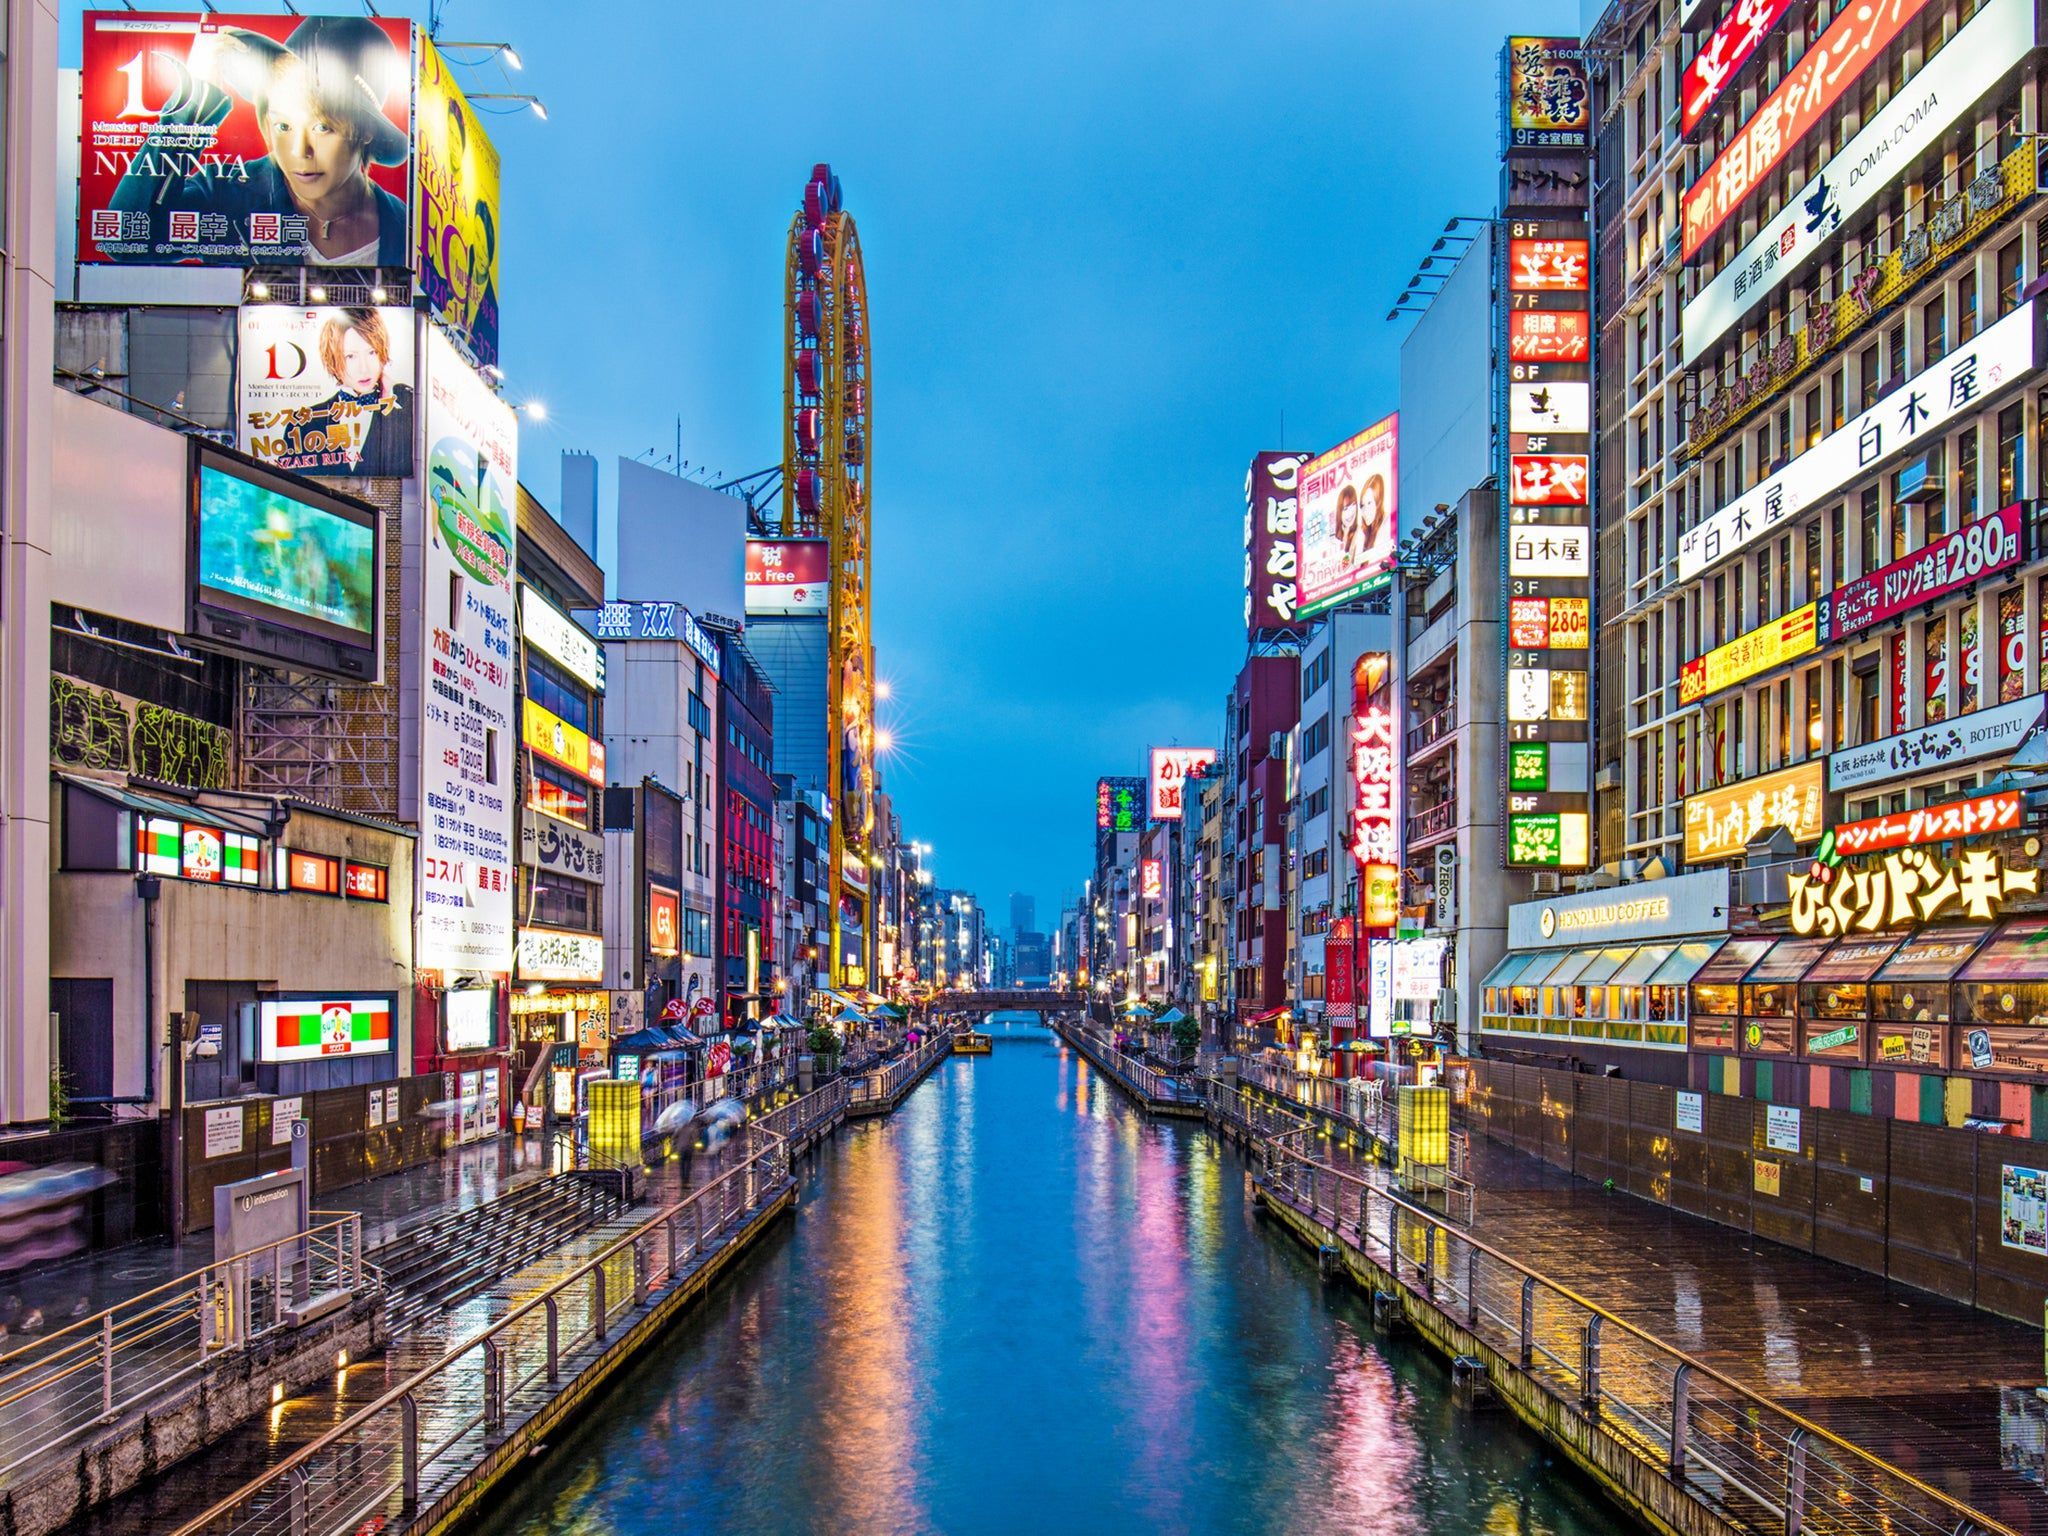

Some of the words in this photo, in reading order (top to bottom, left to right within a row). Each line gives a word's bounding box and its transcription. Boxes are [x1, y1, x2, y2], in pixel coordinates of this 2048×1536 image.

[1716, 0, 1905, 215] 相席ダイニン
[92, 121, 137, 133] Monster
[1516, 128, 1535, 145] 9F
[1538, 132, 1585, 145] 全室個室
[1849, 92, 1938, 188] DOMA-DOMA
[93, 135, 144, 146] DEEP
[148, 136, 218, 148] GROUP
[93, 151, 250, 182] NYANNYA
[92, 210, 151, 241] 最強
[169, 211, 229, 242] 最幸
[250, 212, 309, 244] 最高
[1523, 314, 1556, 333] 相席
[1512, 334, 1587, 357] ダイニング
[247, 395, 401, 430] モンスターグループ
[1858, 352, 1982, 468] 白木屋
[1527, 437, 1548, 451] 5F
[322, 451, 364, 467] RUKA
[1514, 461, 1586, 501] はや
[1683, 532, 1699, 554] 4F
[1704, 482, 1786, 564] 白木屋
[1516, 534, 1582, 561] 白木屋
[745, 571, 762, 582] ax
[765, 570, 796, 582] Free
[1550, 611, 1587, 633] 280円
[1833, 757, 1850, 775] 大阪
[1852, 750, 1886, 769] お好み焼
[1969, 718, 2023, 745] BOTEJYU
[1352, 706, 1392, 864] 大阪王将
[1511, 797, 1538, 811] B1F
[1687, 801, 1706, 825] 2F
[1699, 782, 1802, 853] 山内農場
[1836, 800, 2019, 849] ハンバーグレストラン
[539, 822, 585, 873] うなぎ
[302, 861, 317, 885] 酒
[346, 870, 376, 893] たばこ
[426, 857, 464, 884] コスパ
[1439, 866, 1450, 895] ZERO
[1786, 847, 2039, 936] びっくりドンキー
[1558, 904, 1616, 928] HONOLULU
[1617, 898, 1669, 920] COFFEE
[1914, 1030, 1929, 1039] KEEP
[1912, 1049, 1929, 1061] RIGHT
